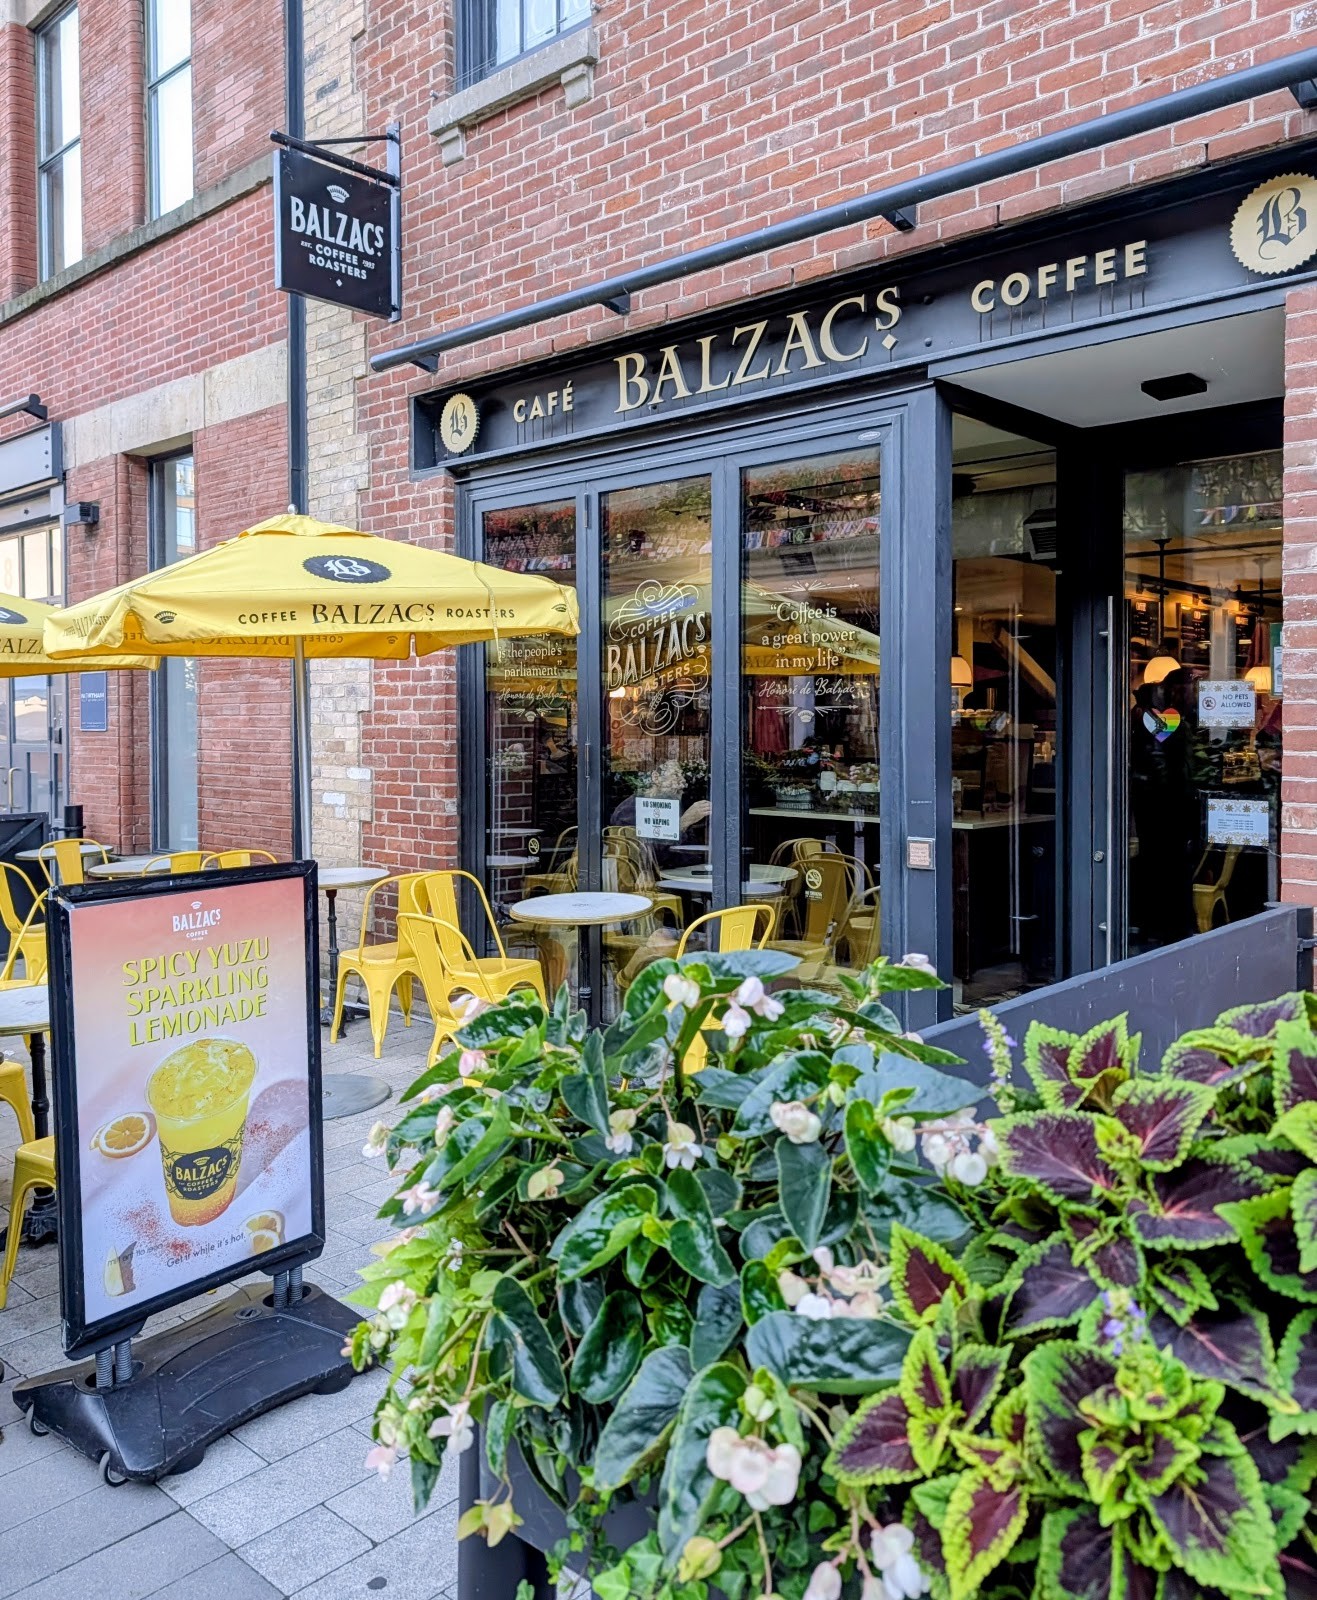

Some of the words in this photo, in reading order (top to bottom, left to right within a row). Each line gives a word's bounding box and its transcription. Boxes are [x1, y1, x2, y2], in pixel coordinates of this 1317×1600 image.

[315, 243, 358, 265] COFFEE
[309, 254, 367, 279] ROASTERS
[513, 380, 574, 423] CAFÉ
[971, 240, 1148, 313] COFFEE
[238, 610, 297, 624] COFFEE
[825, 602, 837, 618] is
[631, 607, 677, 638] COFFEE
[761, 634, 770, 646] a
[772, 631, 808, 649] great
[811, 629, 856, 646] power
[508, 642, 523, 658] the
[525, 640, 562, 660] people's
[776, 653, 789, 668] in
[793, 656, 815, 671] my
[628, 663, 691, 697] OASTERS
[758, 681, 797, 698] Honoré
[800, 681, 811, 695] de
[815, 677, 855, 701] Balzac
[650, 801, 672, 809] SMOKING
[652, 818, 670, 826] VAPING
[186, 930, 208, 938] COFFEE
[121, 948, 201, 987] SPICY
[206, 936, 270, 970] YUZU
[125, 965, 269, 1017] SPARKLING
[129, 993, 268, 1047] LEMONADE
[182, 1180, 219, 1192] ROASTERS
[186, 1177, 213, 1187] COFFEE
[166, 1255, 183, 1268] Get
[185, 1251, 191, 1261] it
[193, 1242, 215, 1257] while
[217, 1237, 229, 1248] it's
[231, 1232, 246, 1243] hot.
